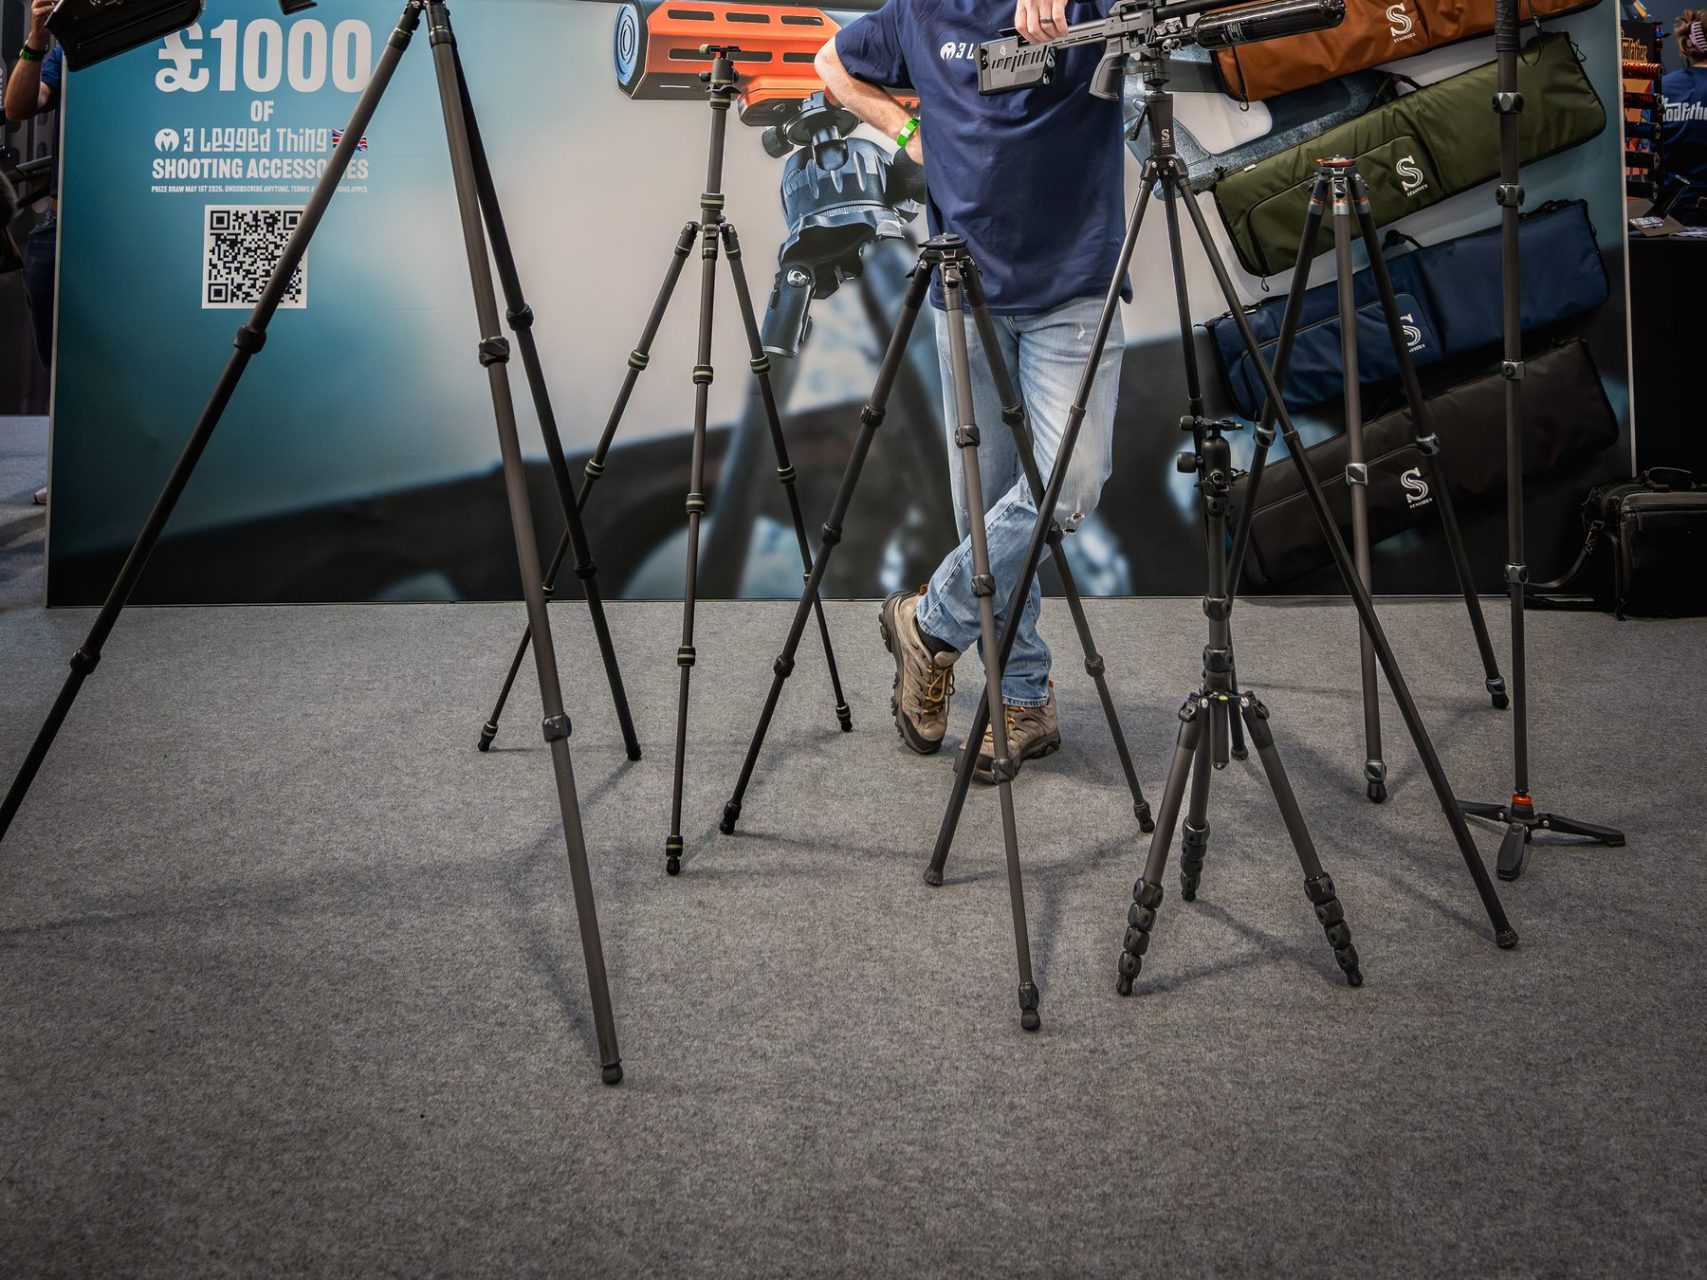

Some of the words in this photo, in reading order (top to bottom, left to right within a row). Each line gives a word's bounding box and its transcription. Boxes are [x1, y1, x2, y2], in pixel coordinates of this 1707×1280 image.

[1385, 2, 1412, 37] S
[155, 18, 372, 93] £1000
[955, 42, 966, 59] 3
[250, 100, 274, 122] OF
[183, 128, 194, 153] 3
[200, 128, 271, 153] Legged
[276, 128, 328, 153] Thing
[151, 158, 243, 179] SHOOTING
[246, 158, 369, 179] ACCESSOES
[1395, 155, 1424, 191] S
[151, 185, 167, 193] PRIZE
[168, 185, 184, 193] DRAW
[184, 185, 197, 193] MAY
[291, 185, 310, 193] TERMS
[1400, 467, 1429, 503] S
